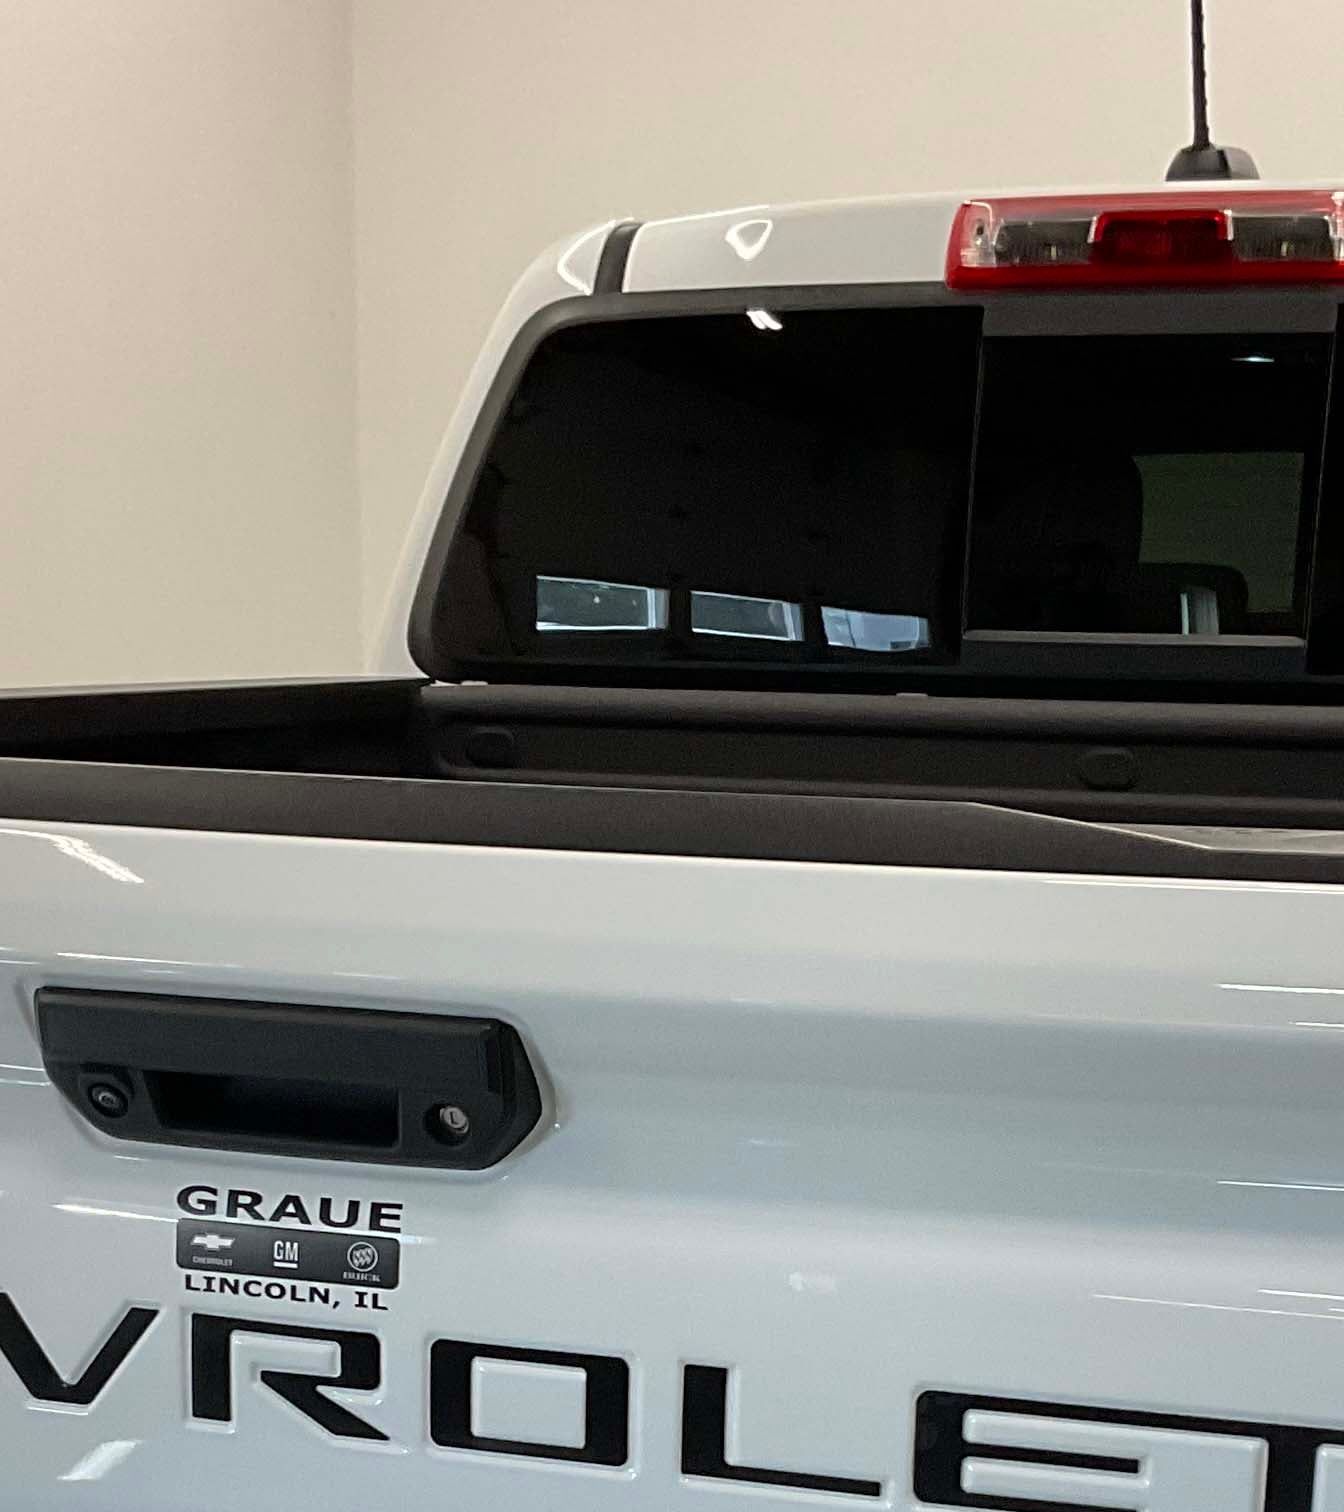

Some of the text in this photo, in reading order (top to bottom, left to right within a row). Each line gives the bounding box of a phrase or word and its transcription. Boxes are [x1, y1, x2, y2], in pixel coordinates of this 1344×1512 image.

[176, 1185, 404, 1234] GRAUE
[273, 1239, 299, 1262] GM
[184, 1274, 389, 1311] LINCOLN, IL
